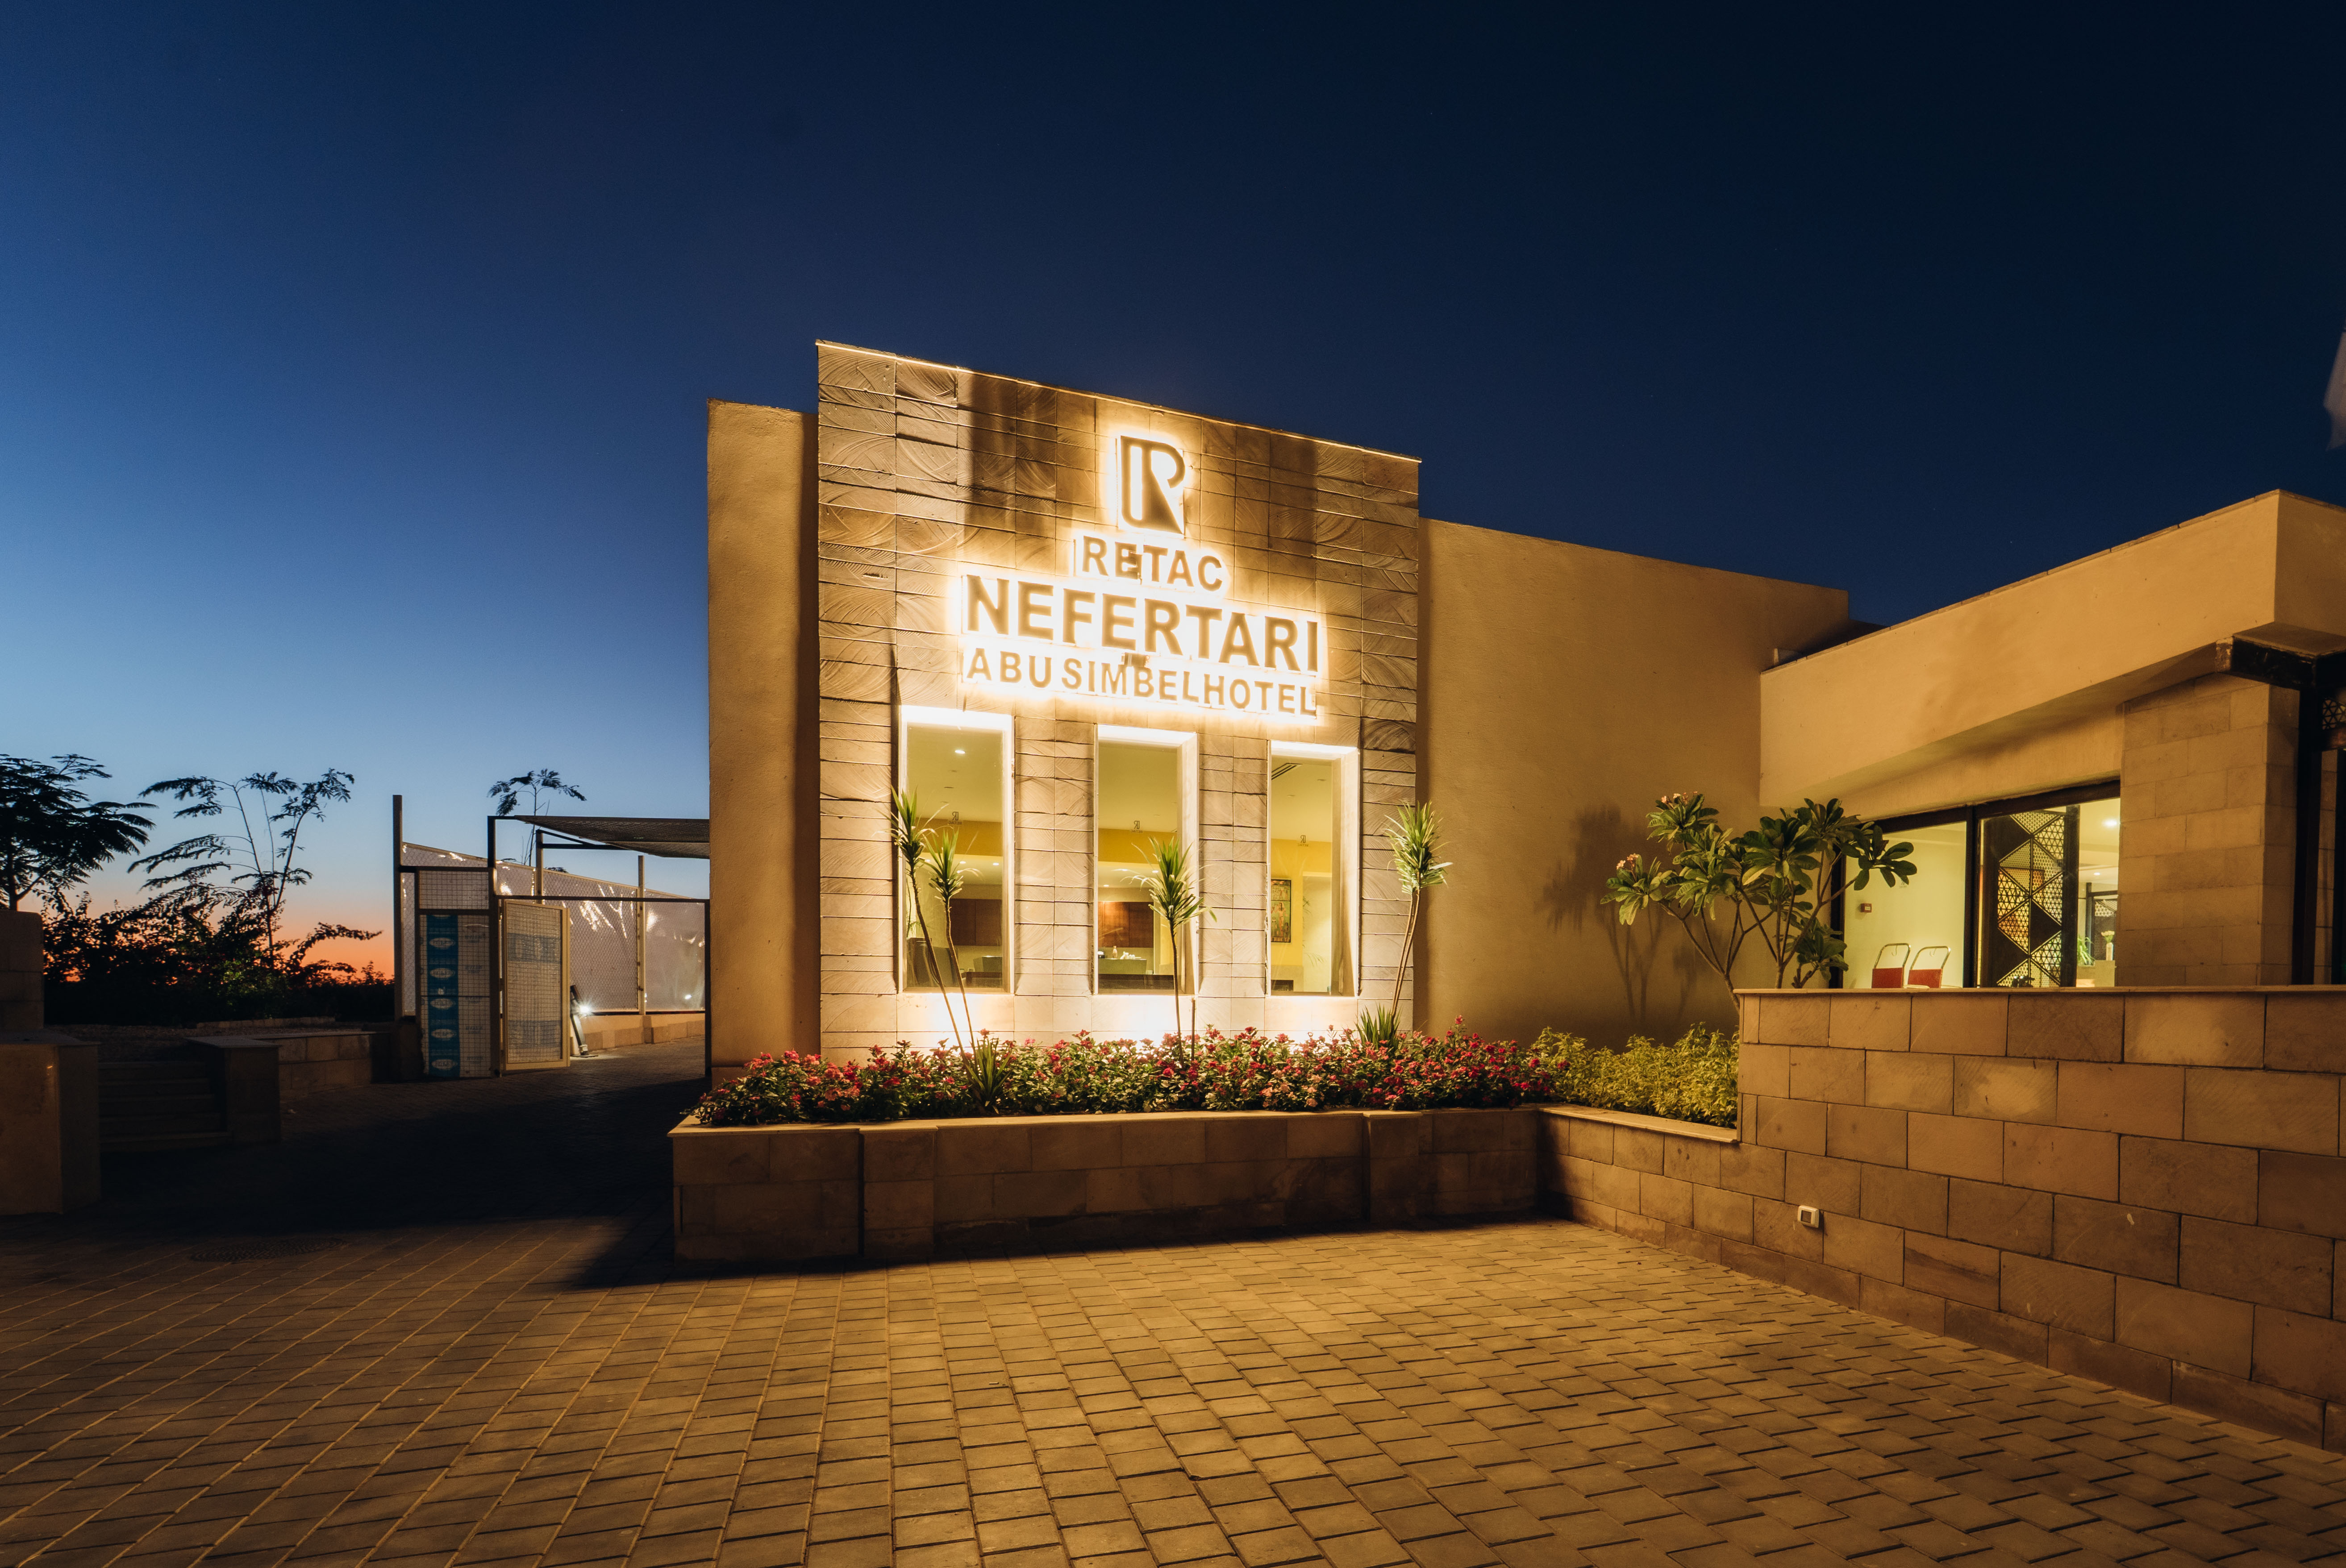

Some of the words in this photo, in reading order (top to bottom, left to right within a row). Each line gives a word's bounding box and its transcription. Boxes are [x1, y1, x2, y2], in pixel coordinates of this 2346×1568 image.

[1082, 536, 1222, 591] RETAC
[966, 574, 1318, 672] NEFERTARI
[967, 648, 1052, 688] ABU
